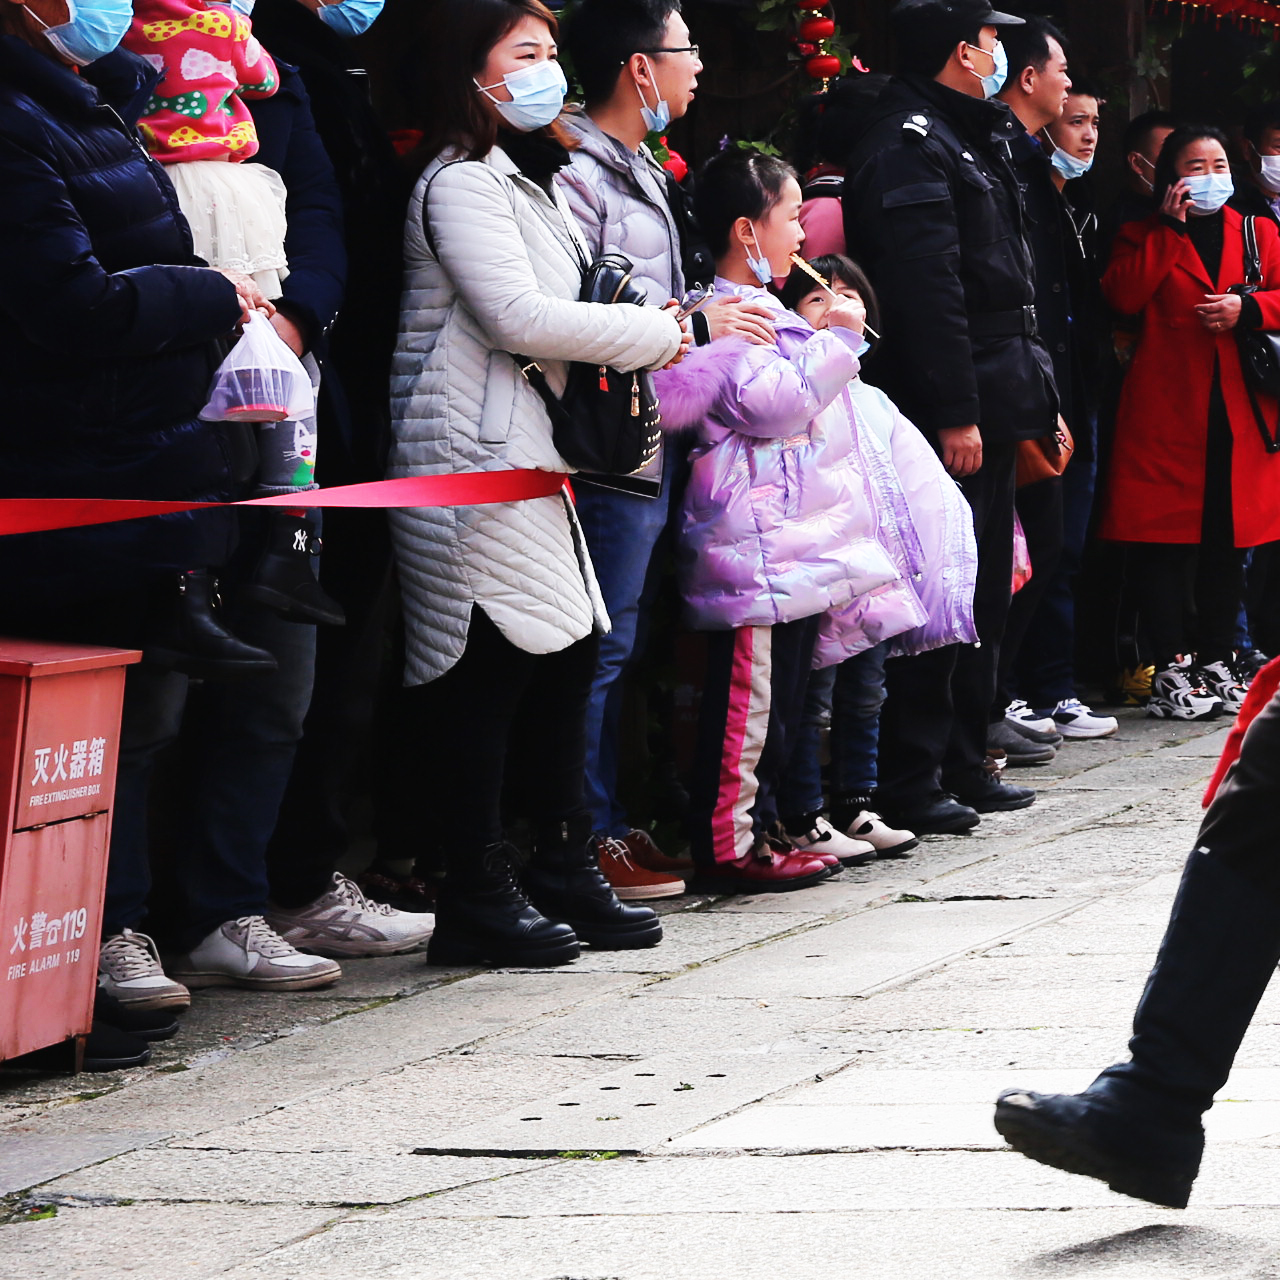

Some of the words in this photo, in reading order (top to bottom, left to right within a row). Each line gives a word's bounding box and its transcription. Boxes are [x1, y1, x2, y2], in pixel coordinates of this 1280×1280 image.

[31, 736, 106, 787] 灭火器箱
[29, 794, 45, 808] FIRE
[43, 785, 88, 805] EXTINGUISHER
[87, 783, 101, 796] BOX
[10, 911, 48, 955] 火警
[63, 907, 87, 942] 119
[7, 962, 27, 981] FIRE
[28, 952, 61, 975] ALARM
[66, 948, 80, 964] 119
